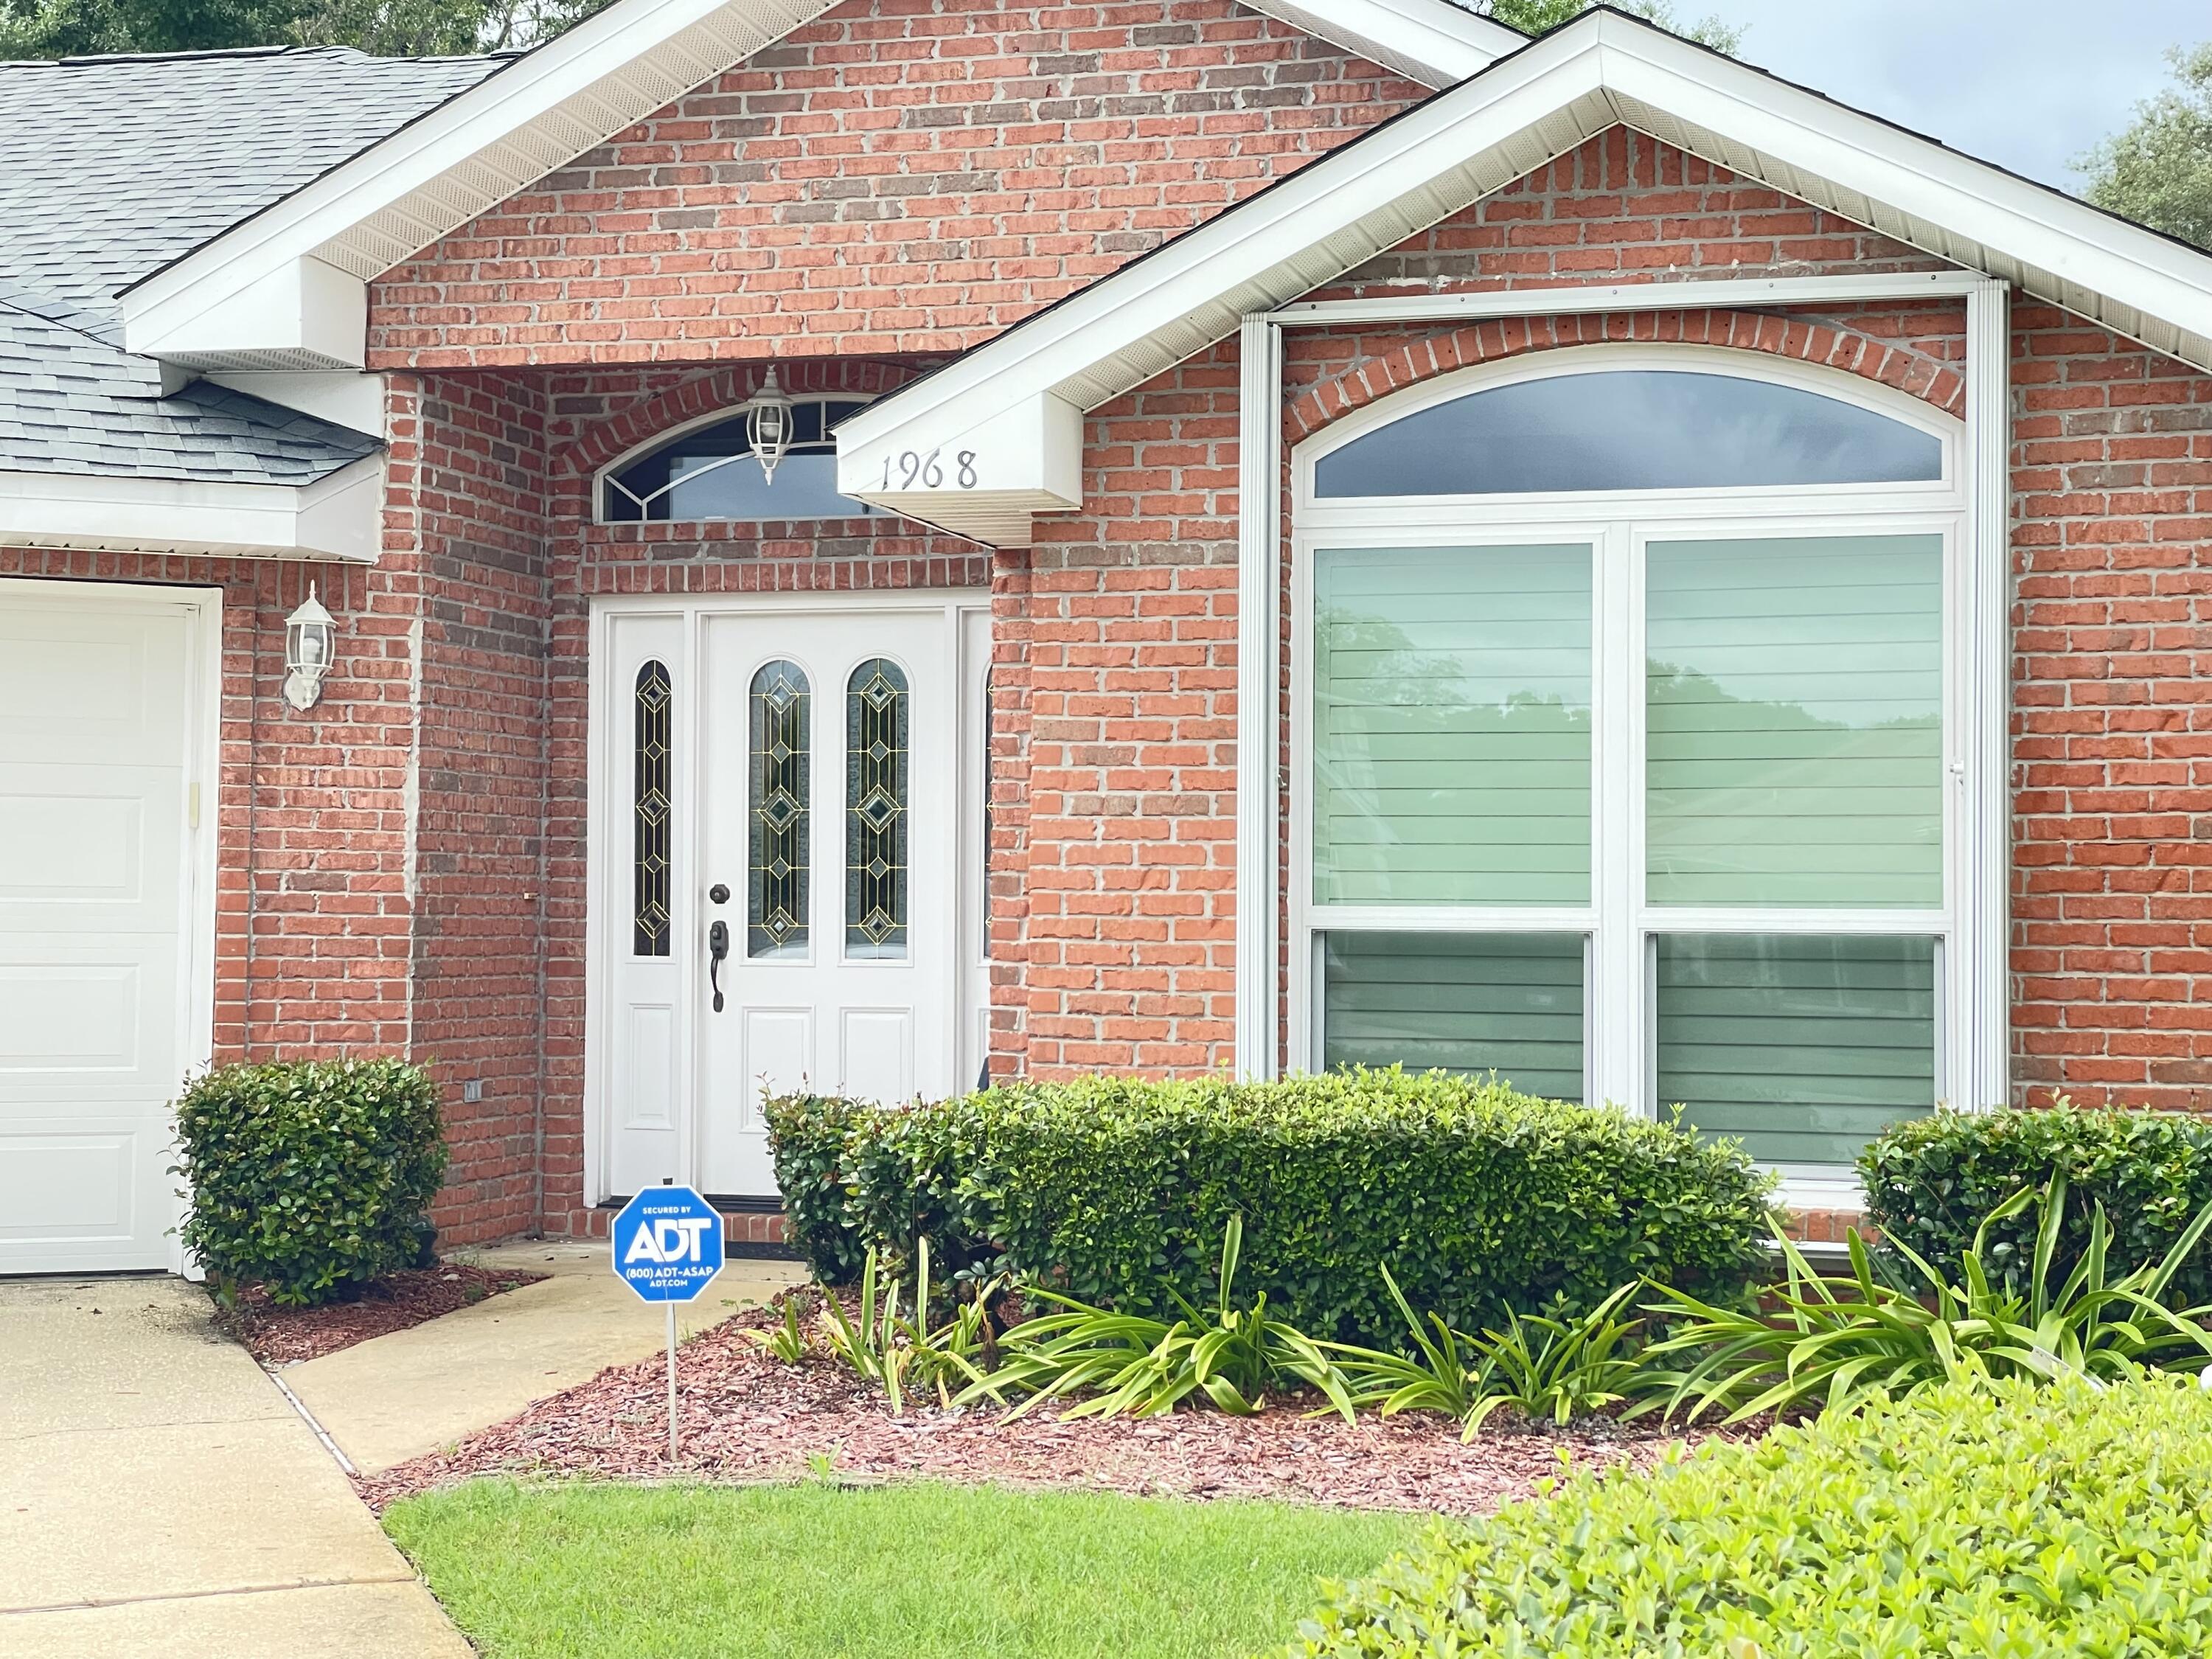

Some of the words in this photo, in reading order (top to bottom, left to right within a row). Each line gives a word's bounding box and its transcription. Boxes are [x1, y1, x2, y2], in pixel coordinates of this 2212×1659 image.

[882, 448, 977, 492] 1968
[642, 1206, 679, 1214] SECURED
[624, 1218, 712, 1264] ADT
[626, 1267, 654, 1280] (800)
[655, 1266, 714, 1278] ADT-ASAP
[650, 1279, 688, 1287] ADT.COM
